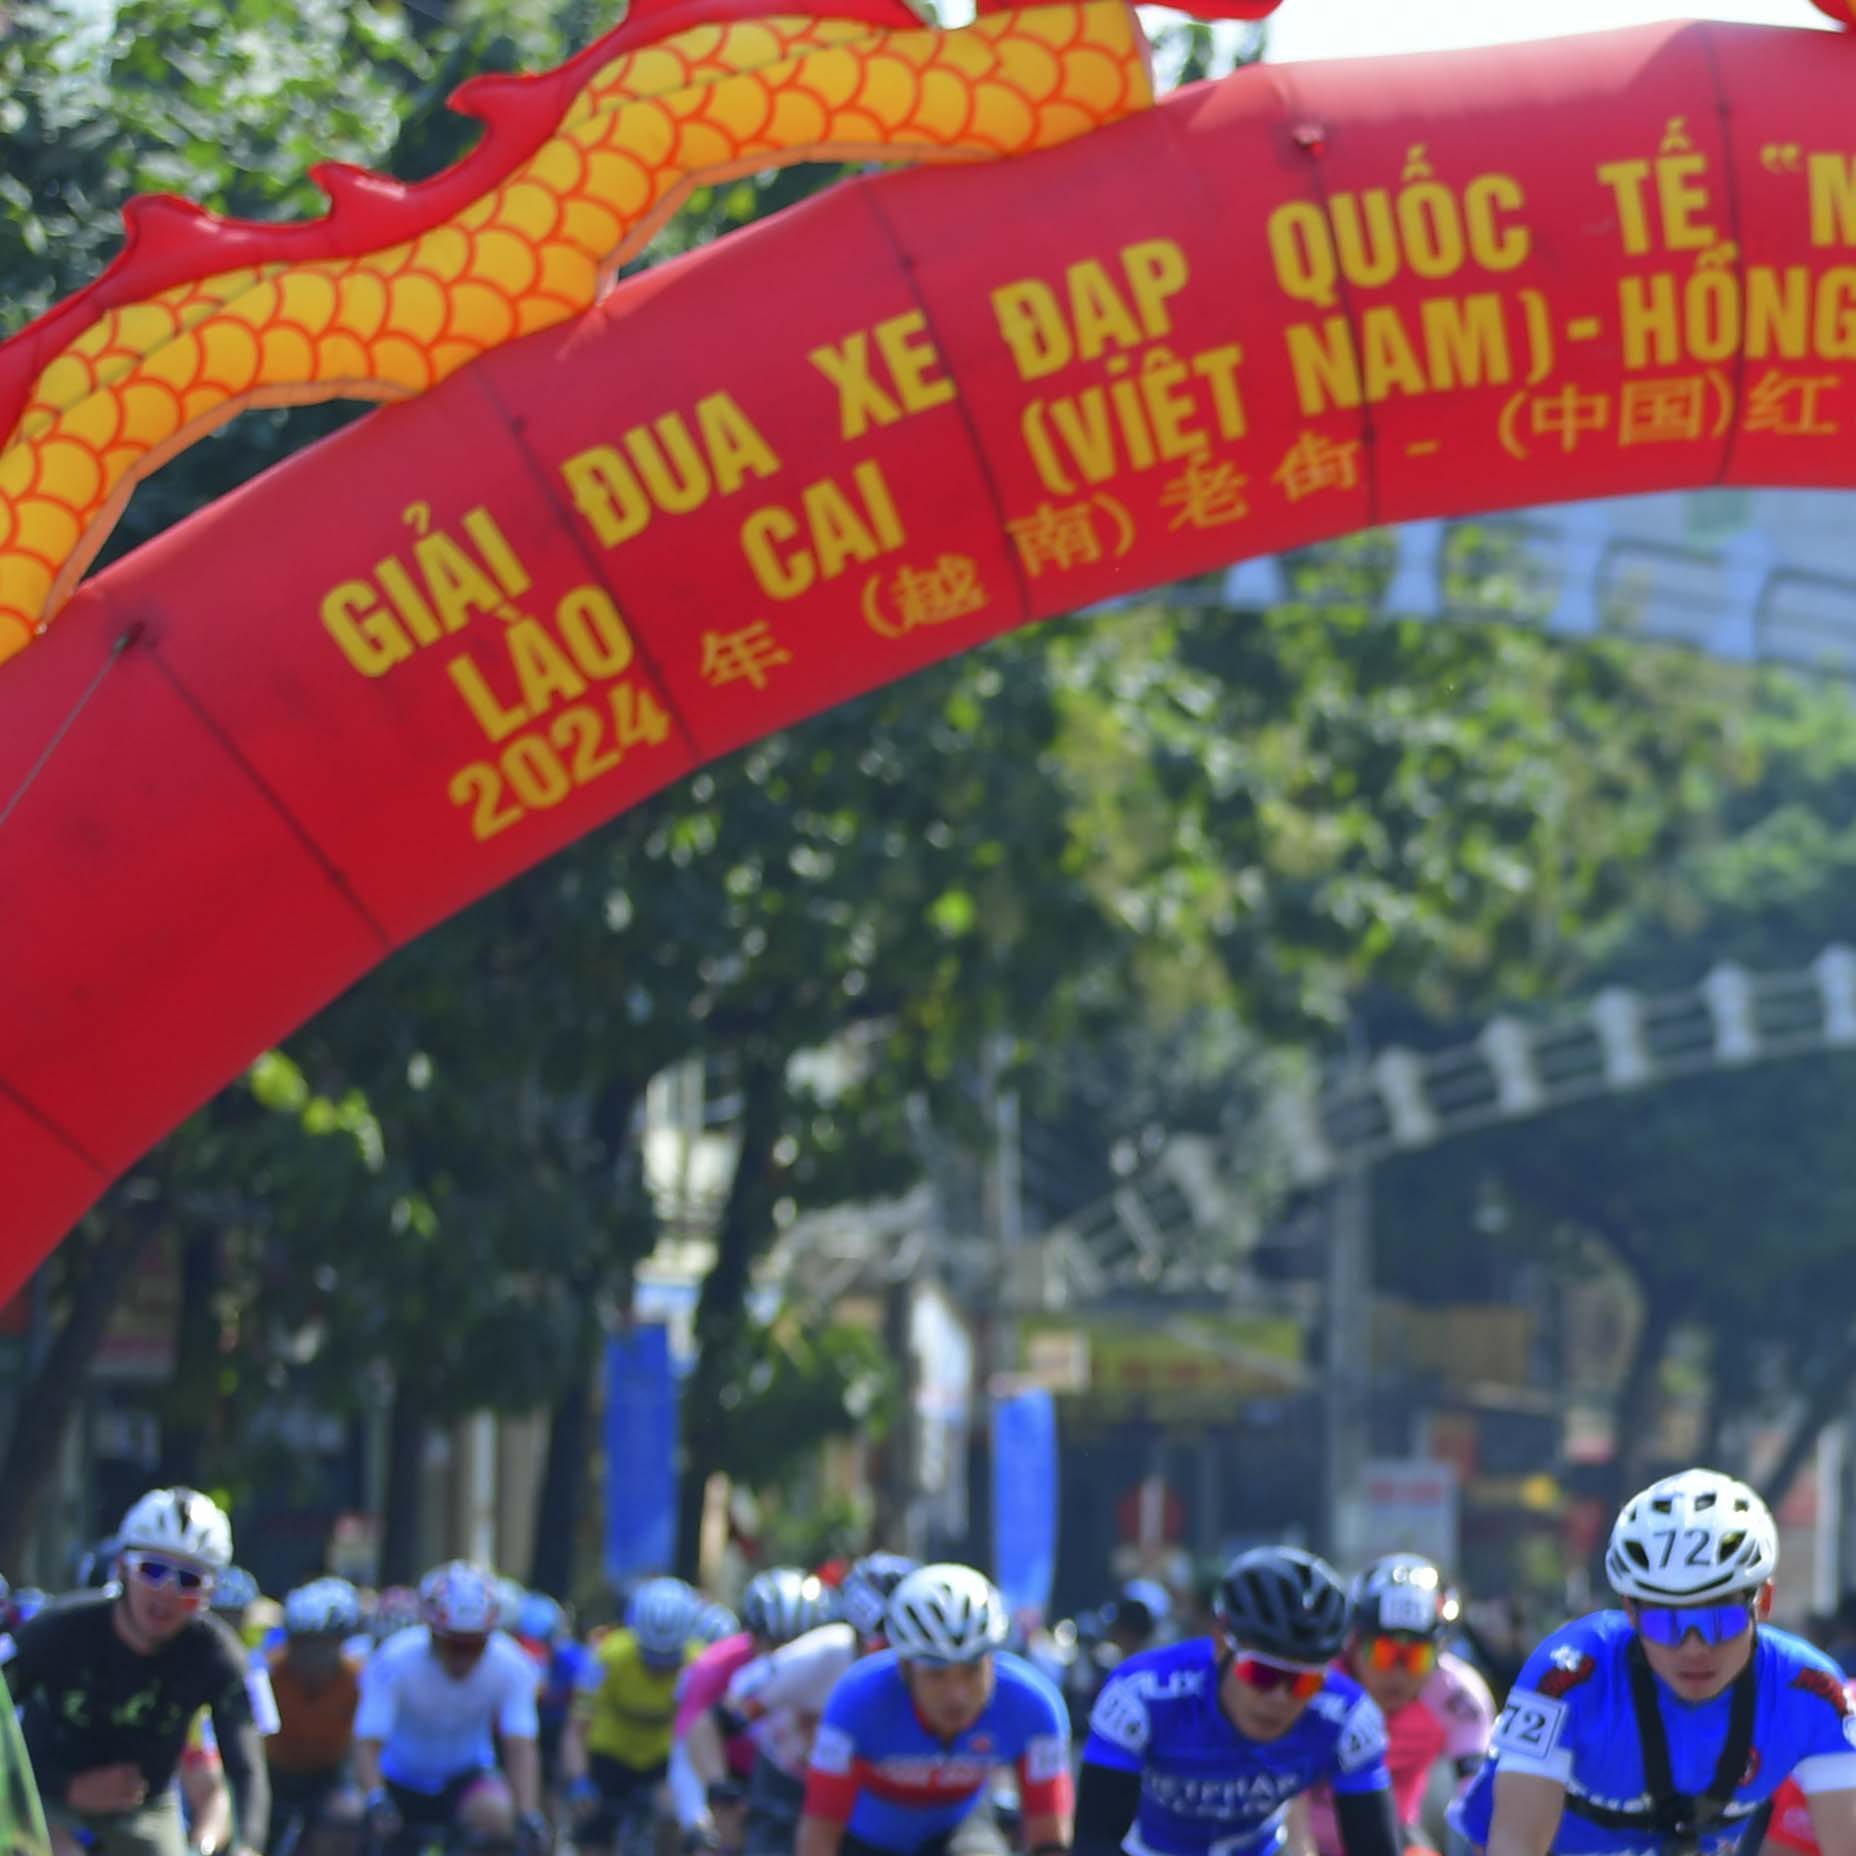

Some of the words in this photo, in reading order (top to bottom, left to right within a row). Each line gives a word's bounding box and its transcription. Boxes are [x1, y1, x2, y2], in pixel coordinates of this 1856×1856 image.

[320, 500, 534, 680] GIẢI
[560, 388, 782, 551] ĐUA
[807, 308, 958, 442] XE
[989, 237, 1190, 382] ĐẠP
[1266, 143, 1532, 307] QUỐC
[1596, 115, 1718, 256] TẾ
[446, 584, 635, 744] LÀO
[739, 458, 908, 602] CAI
[1020, 342, 1247, 497] (VIỆT
[1653, 1529, 1712, 1569] 72
[1500, 1703, 1547, 1744] 72
